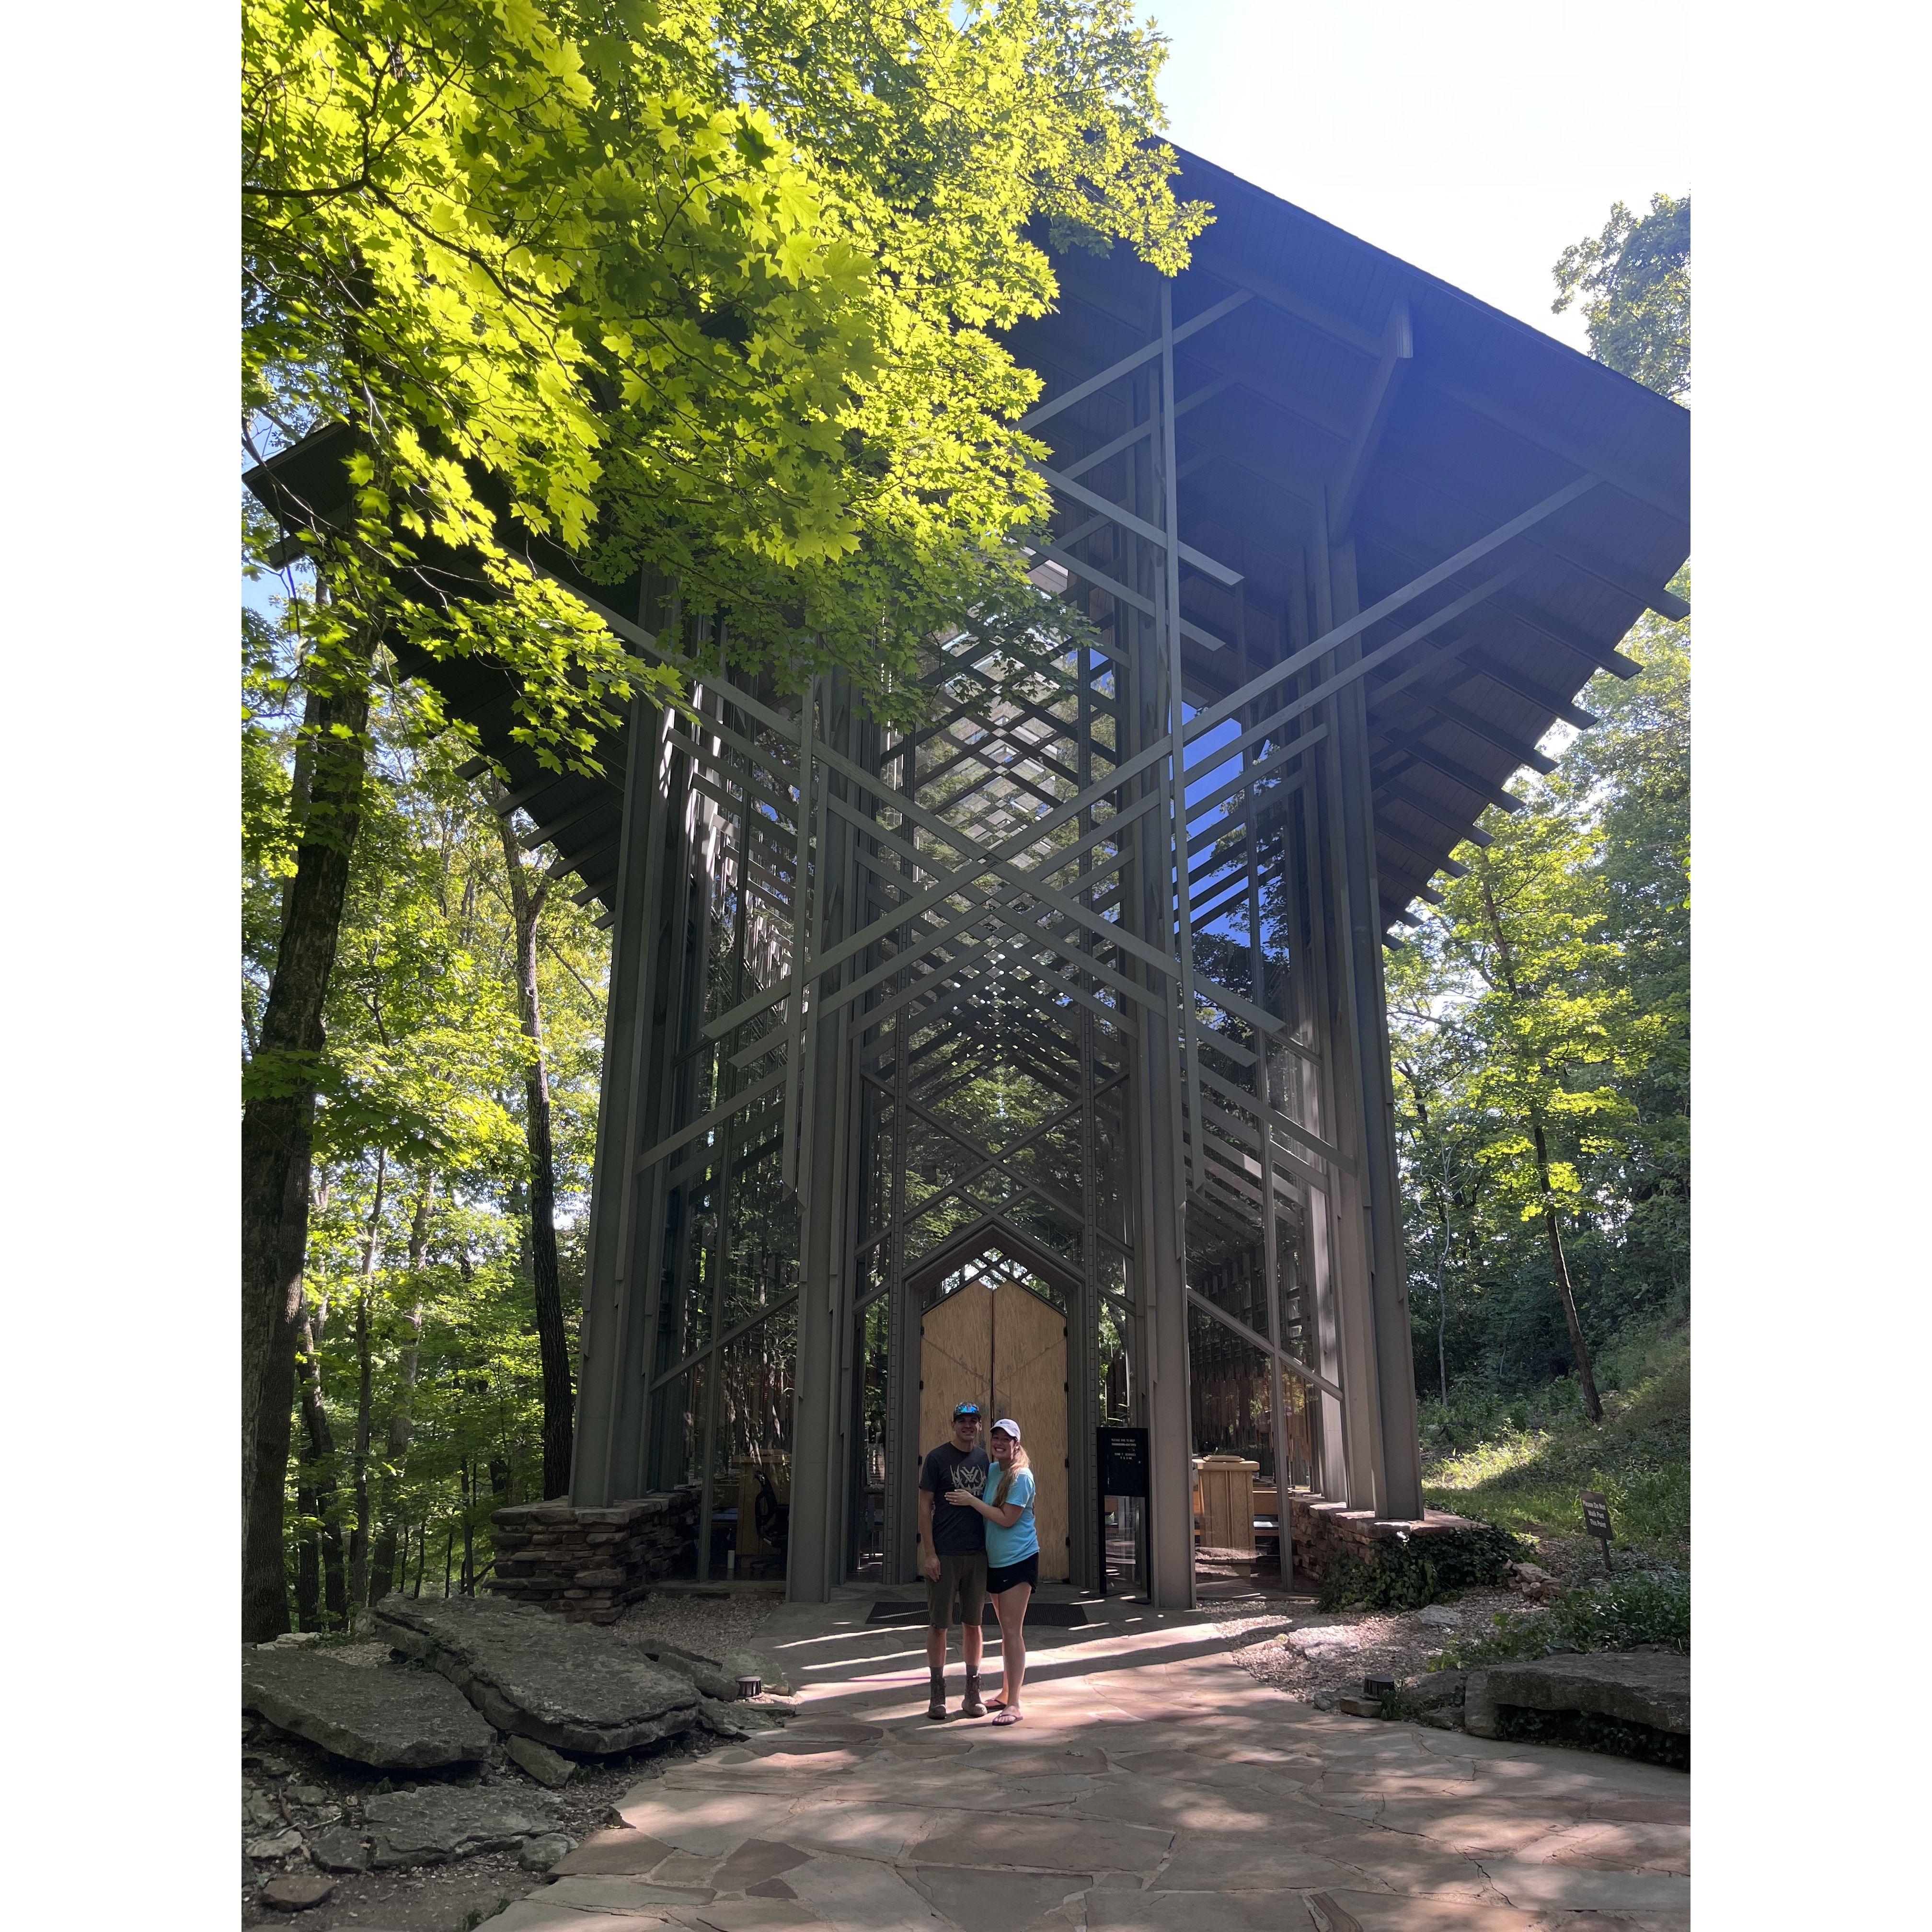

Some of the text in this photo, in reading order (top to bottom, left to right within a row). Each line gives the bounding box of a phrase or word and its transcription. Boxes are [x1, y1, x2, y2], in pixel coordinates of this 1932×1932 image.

[1582, 1500, 1594, 1508] Please
[1587, 1509, 1597, 1518] Walk
[1597, 1520, 1607, 1529] Point
